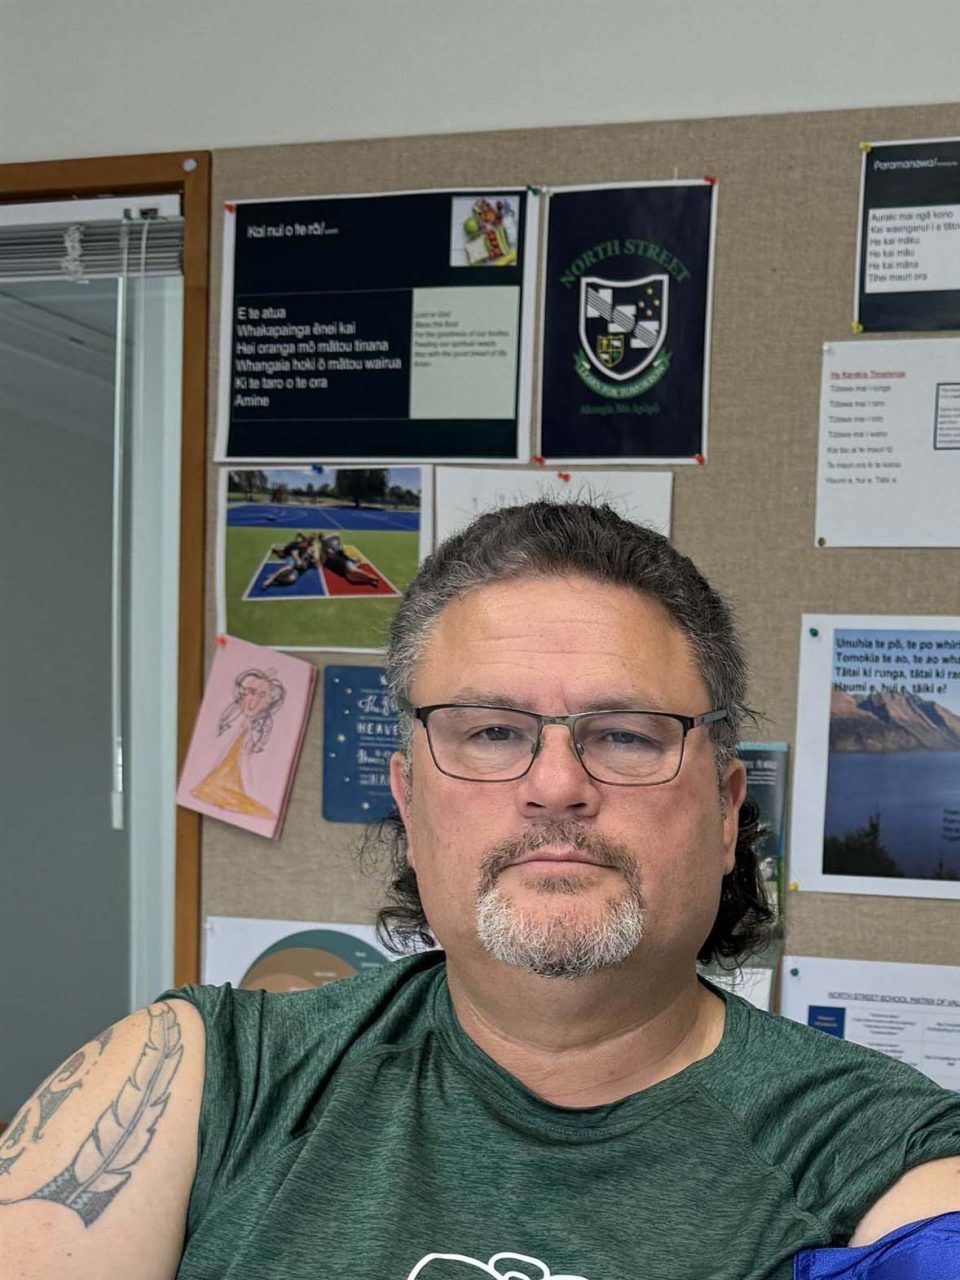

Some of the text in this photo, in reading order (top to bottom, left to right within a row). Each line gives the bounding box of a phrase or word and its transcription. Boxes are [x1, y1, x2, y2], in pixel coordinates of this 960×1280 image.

[560, 239, 691, 289] NORTH STREET
[238, 307, 246, 319] E
[836, 638, 873, 649] Unuhia
[874, 639, 885, 649] te
[907, 639, 918, 650] te
[836, 653, 880, 664] Tomokia
[882, 653, 892, 663] te
[913, 654, 923, 664] te
[862, 667, 873, 678] ki
[935, 668, 945, 679] ki
[357, 722, 400, 736] HEAVE
